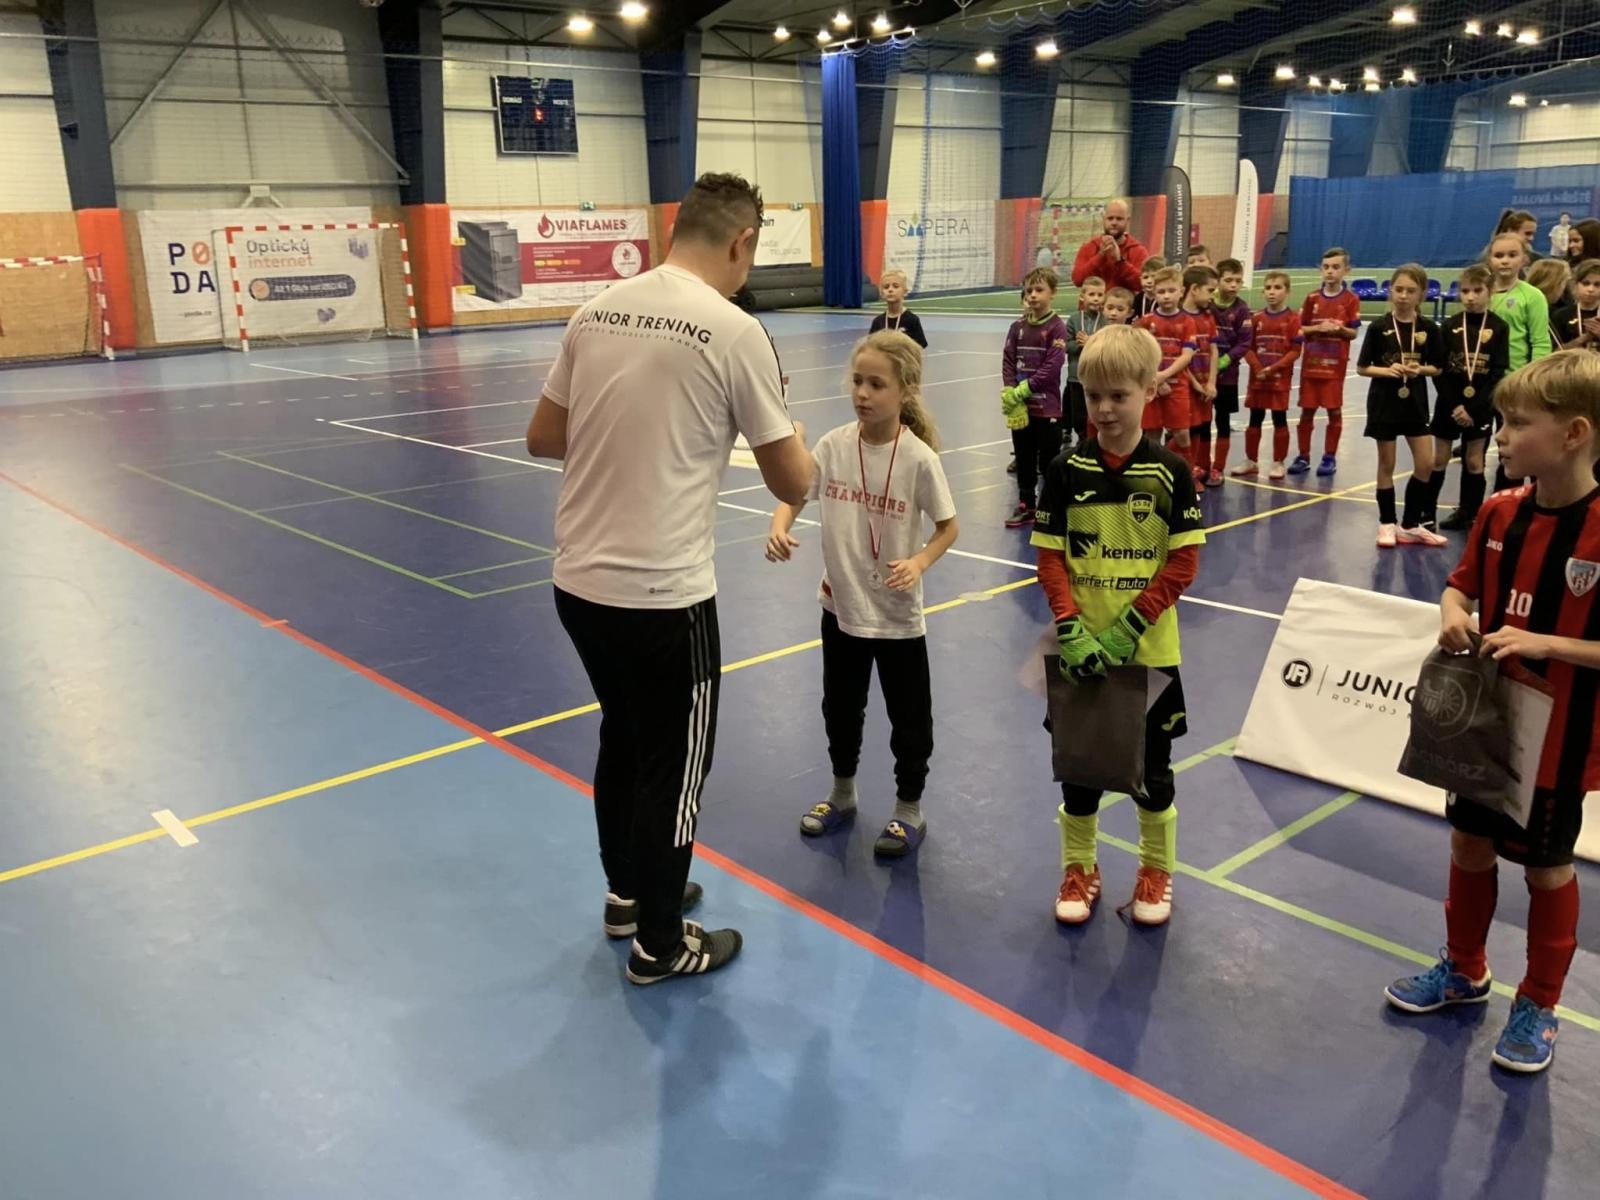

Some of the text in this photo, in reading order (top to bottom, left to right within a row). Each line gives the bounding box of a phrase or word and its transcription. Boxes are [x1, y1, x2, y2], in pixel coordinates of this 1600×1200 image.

[555, 219, 627, 232] VIAFLAMES
[246, 237, 310, 256] Optický
[249, 254, 313, 270] internet
[170, 270, 216, 294] DA
[578, 310, 712, 344] JUNIOR TRENING
[825, 485, 906, 513] CHAMPIONS
[1101, 545, 1157, 560] kensol
[1117, 578, 1147, 590] auto
[1505, 589, 1533, 618] 10
[1331, 693, 1397, 715] ROZWÓJ
